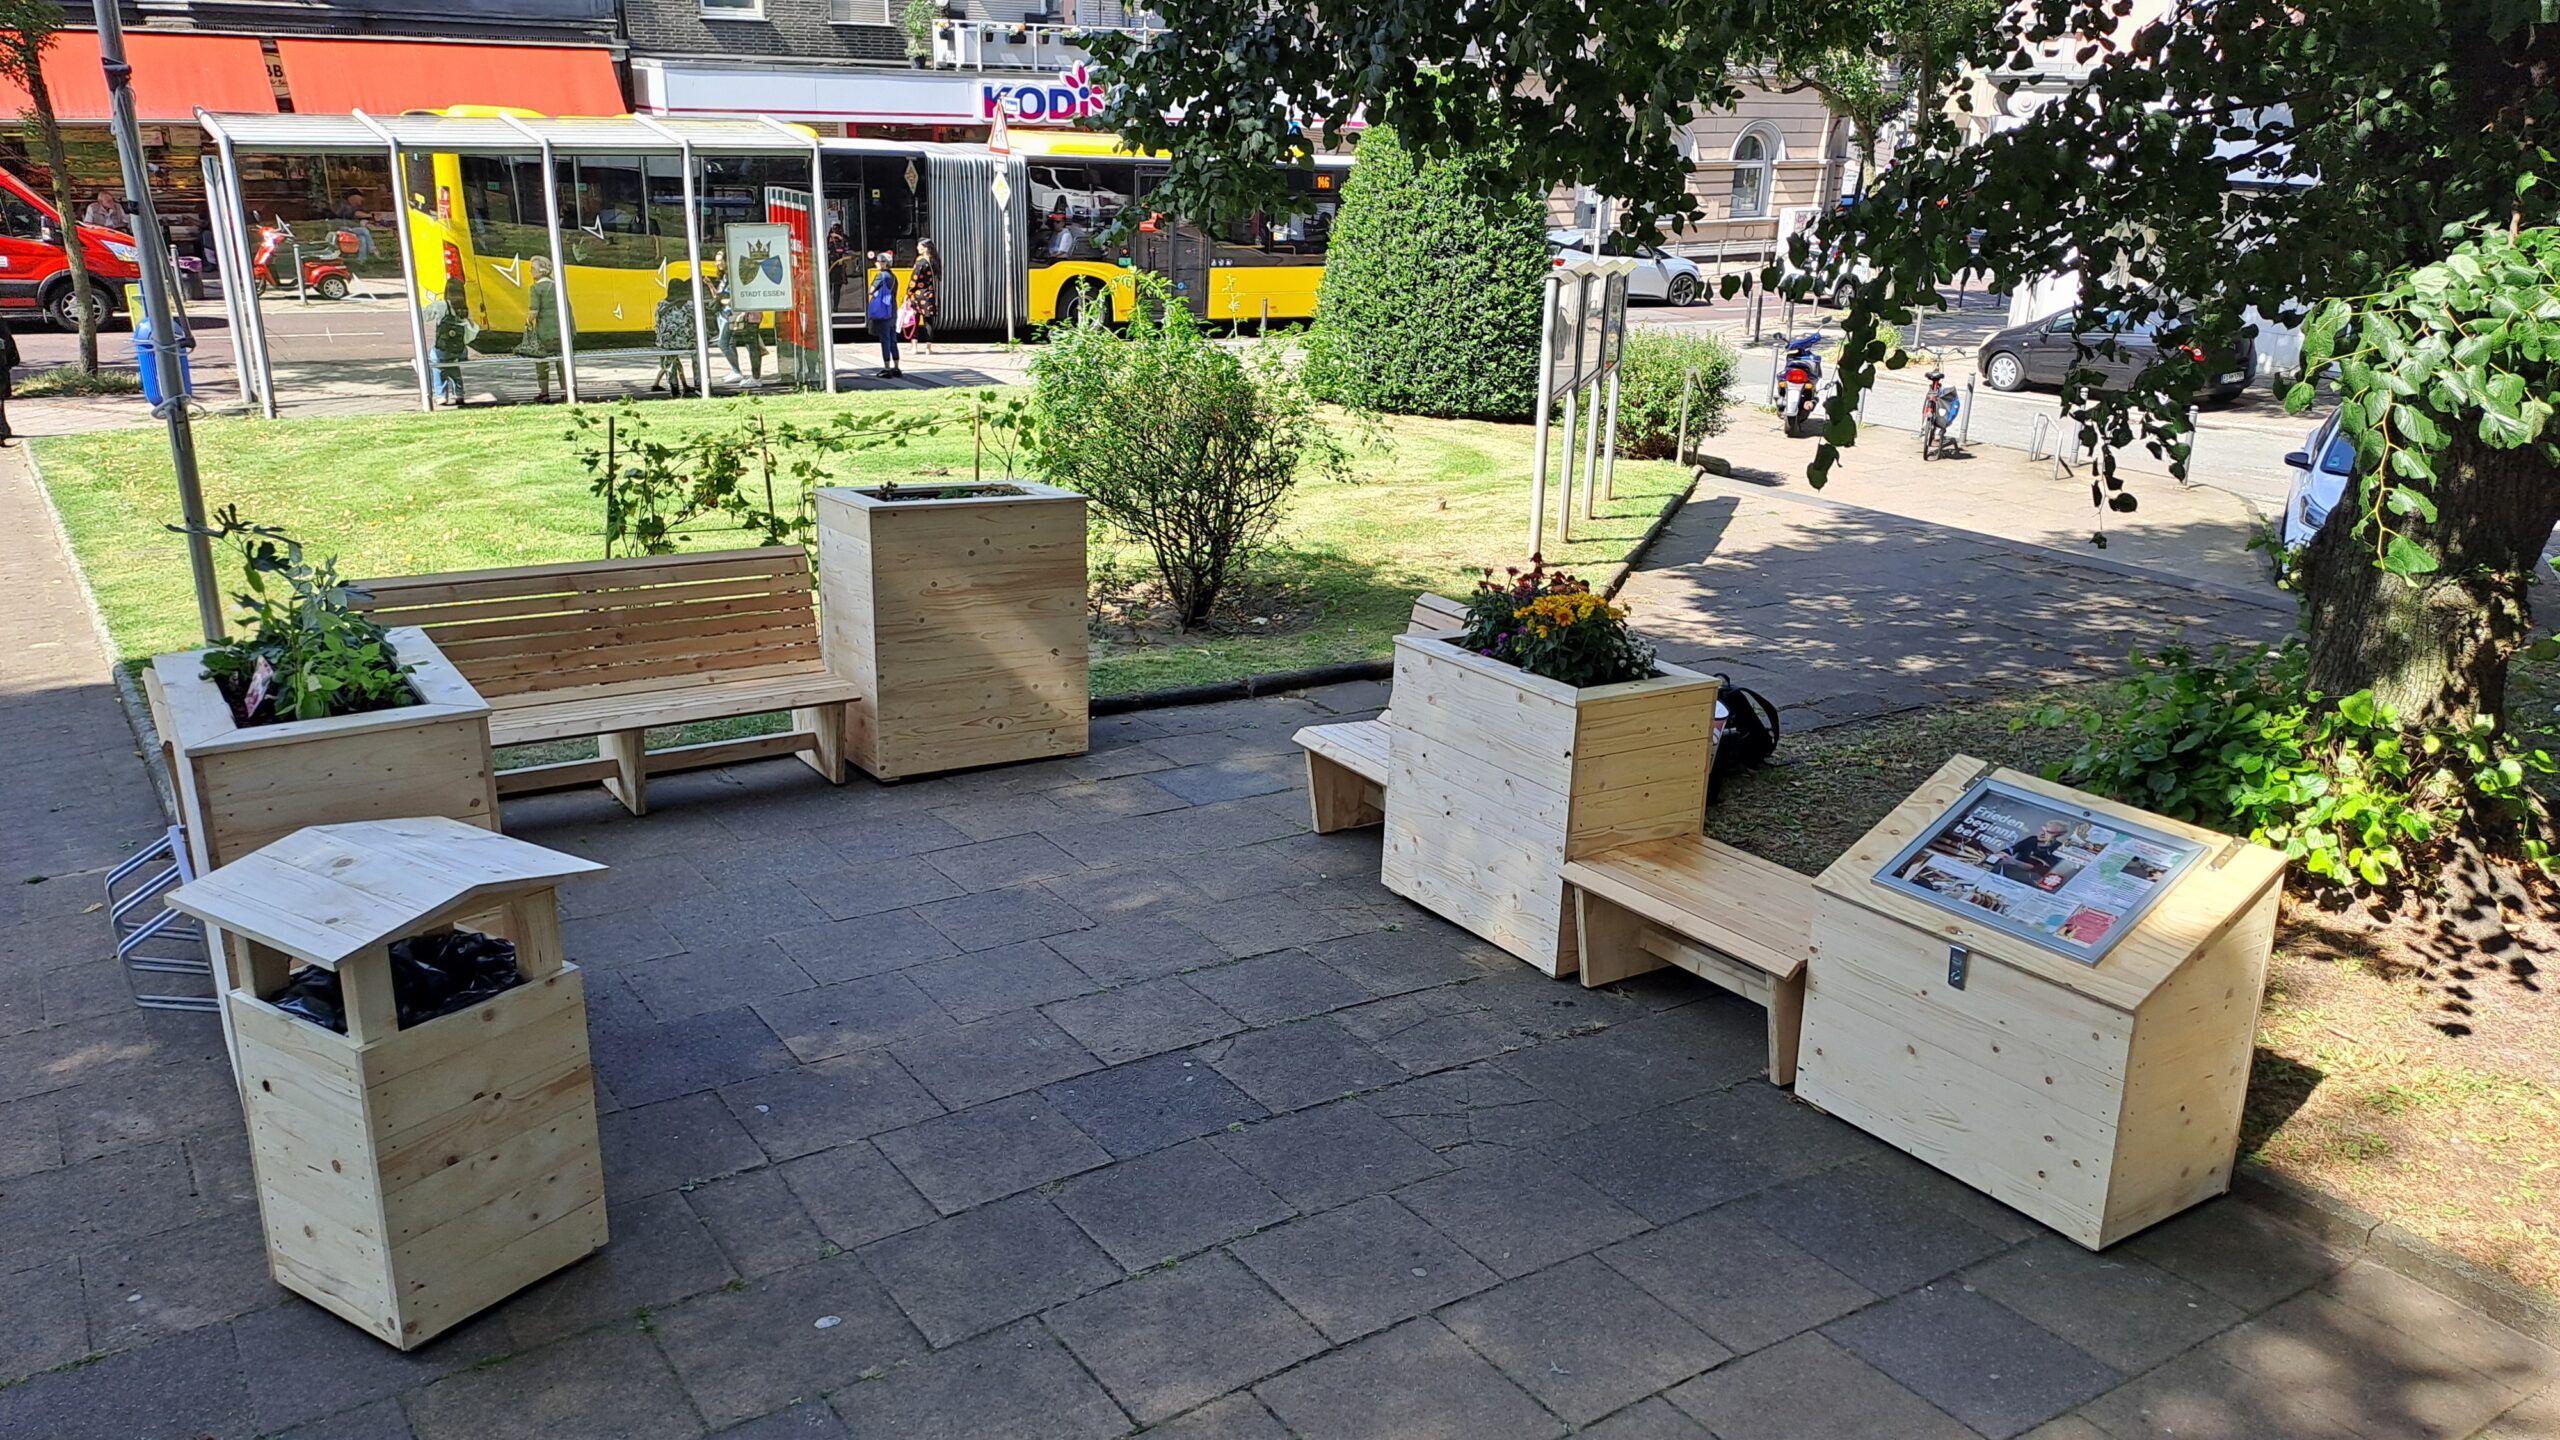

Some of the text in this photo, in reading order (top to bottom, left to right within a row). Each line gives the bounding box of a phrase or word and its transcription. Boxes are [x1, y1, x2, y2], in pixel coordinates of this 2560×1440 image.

[740, 290, 761, 298] STADT
[1973, 805, 2025, 829] Frieden
[1953, 823, 1979, 838] bei
